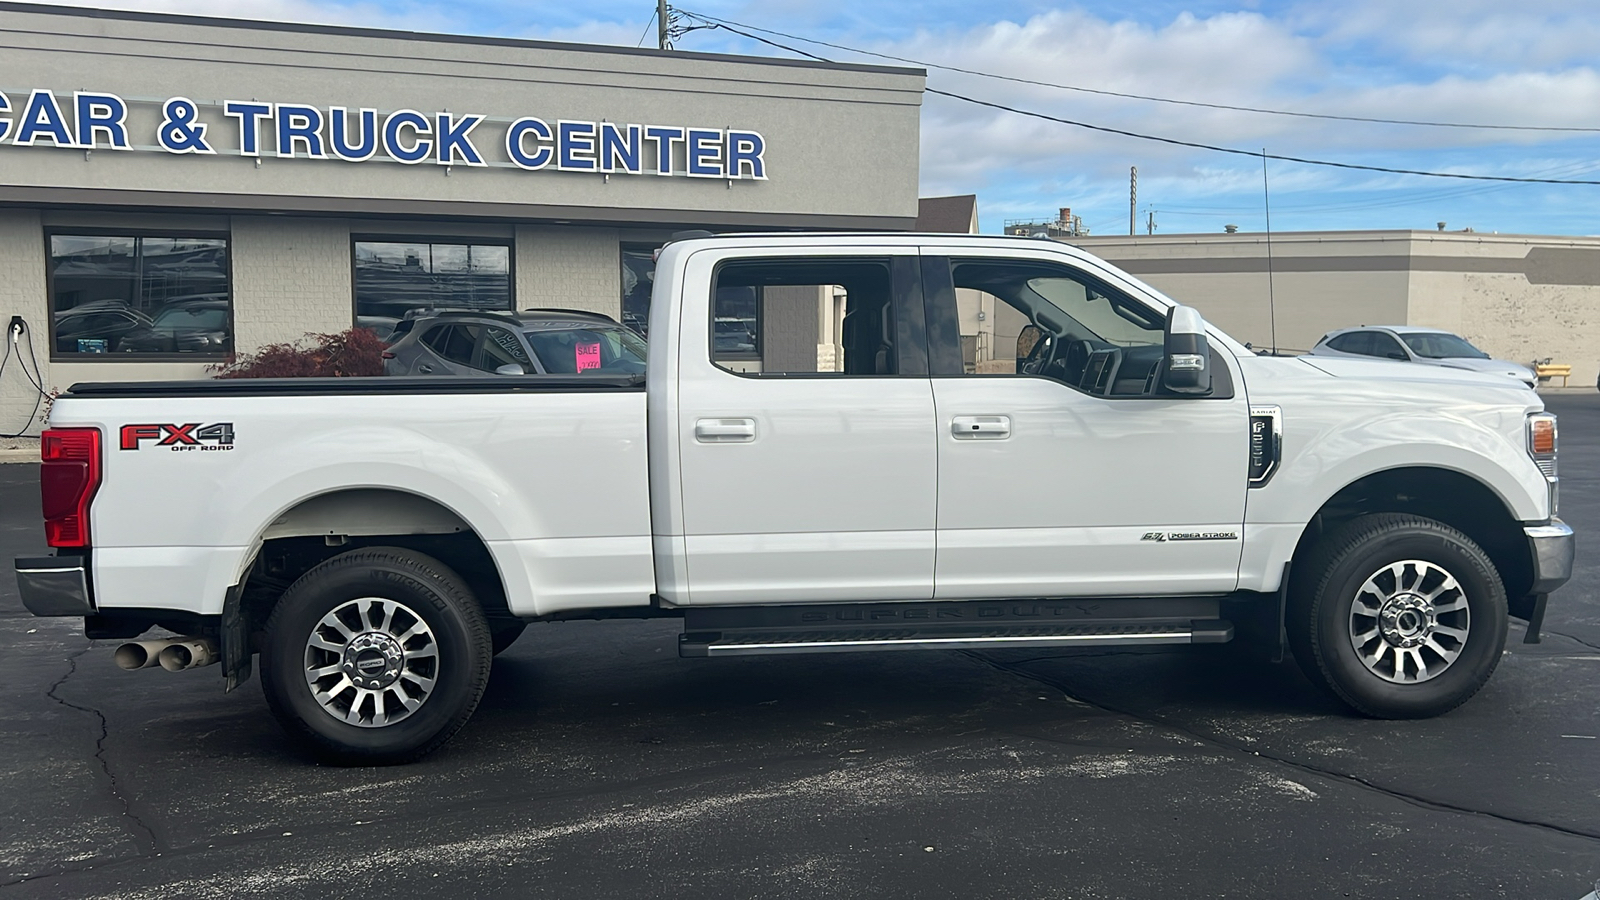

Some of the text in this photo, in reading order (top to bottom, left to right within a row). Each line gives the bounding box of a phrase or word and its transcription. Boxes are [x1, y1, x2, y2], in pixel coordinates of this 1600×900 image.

[0, 88, 769, 181] AR & TRUCK CENTER
[577, 346, 598, 355] SALE
[119, 422, 235, 451] FX4
[387, 572, 448, 611] MICHELIN
[801, 604, 1101, 622] SUPER DUTY
